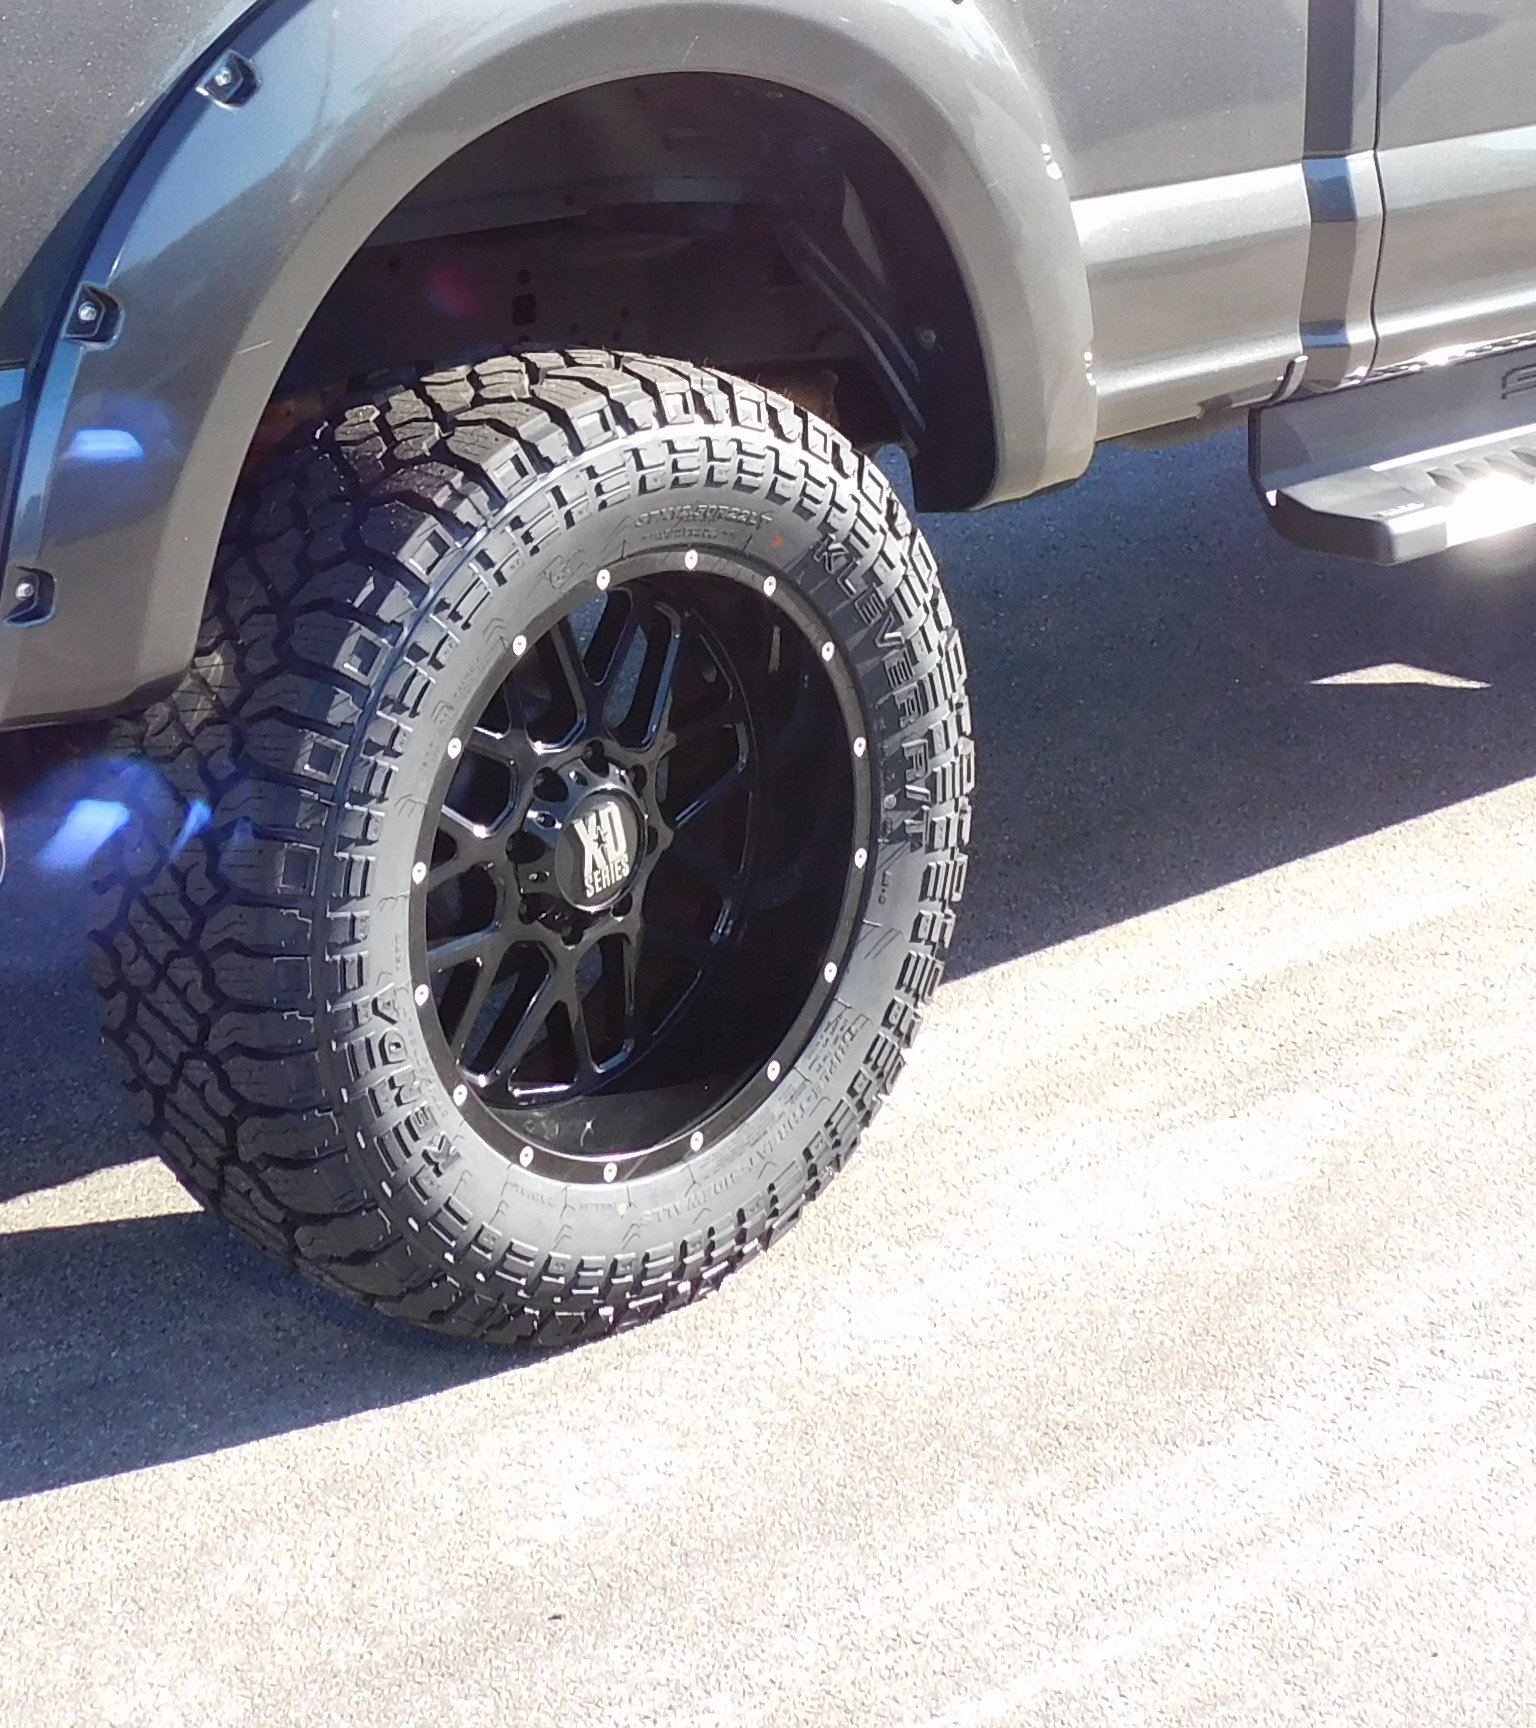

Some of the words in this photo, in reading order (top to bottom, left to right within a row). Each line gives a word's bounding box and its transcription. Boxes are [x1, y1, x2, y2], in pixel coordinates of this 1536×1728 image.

[813, 523, 925, 729] KLEVER
[584, 852, 630, 898] SERIES
[371, 981, 463, 1179] KENDA
